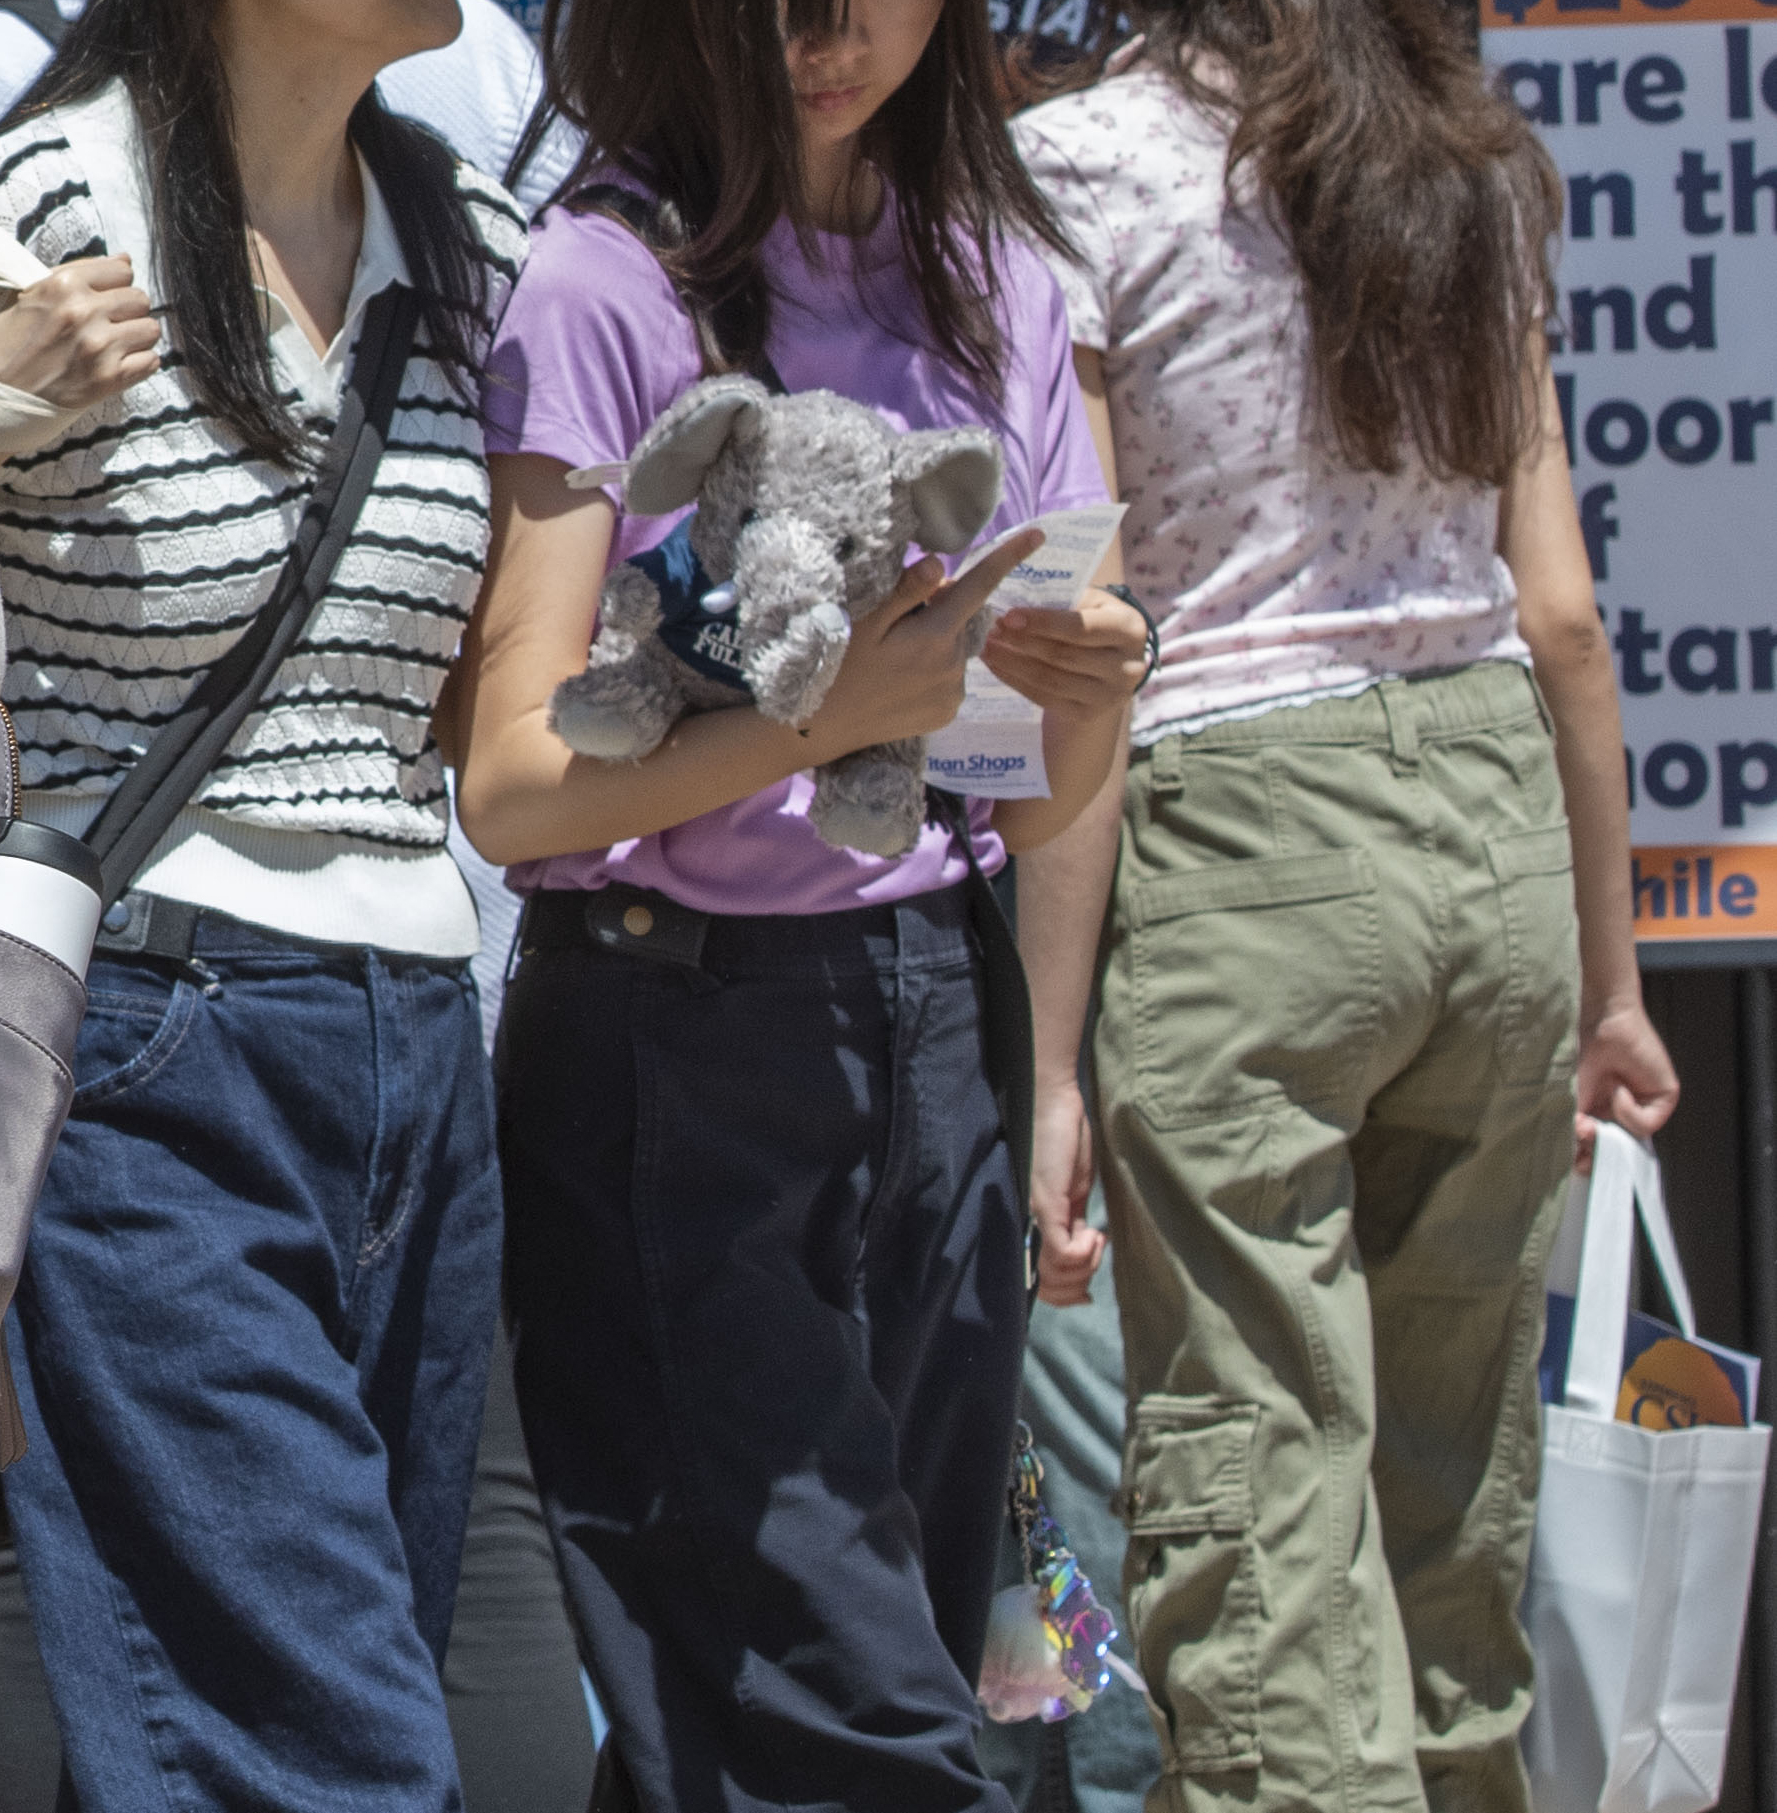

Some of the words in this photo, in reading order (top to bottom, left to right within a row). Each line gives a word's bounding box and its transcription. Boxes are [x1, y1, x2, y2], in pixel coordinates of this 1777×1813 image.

[1495, 55, 1686, 126] are
[1568, 171, 1636, 238] n
[1548, 253, 1716, 354] nd
[1554, 373, 1775, 470] loor
[1580, 481, 1620, 581] f
[692, 631, 745, 670] FUL
[927, 755, 966, 772] itan
[968, 753, 1027, 772] Shops
[1631, 857, 1757, 920] hile
